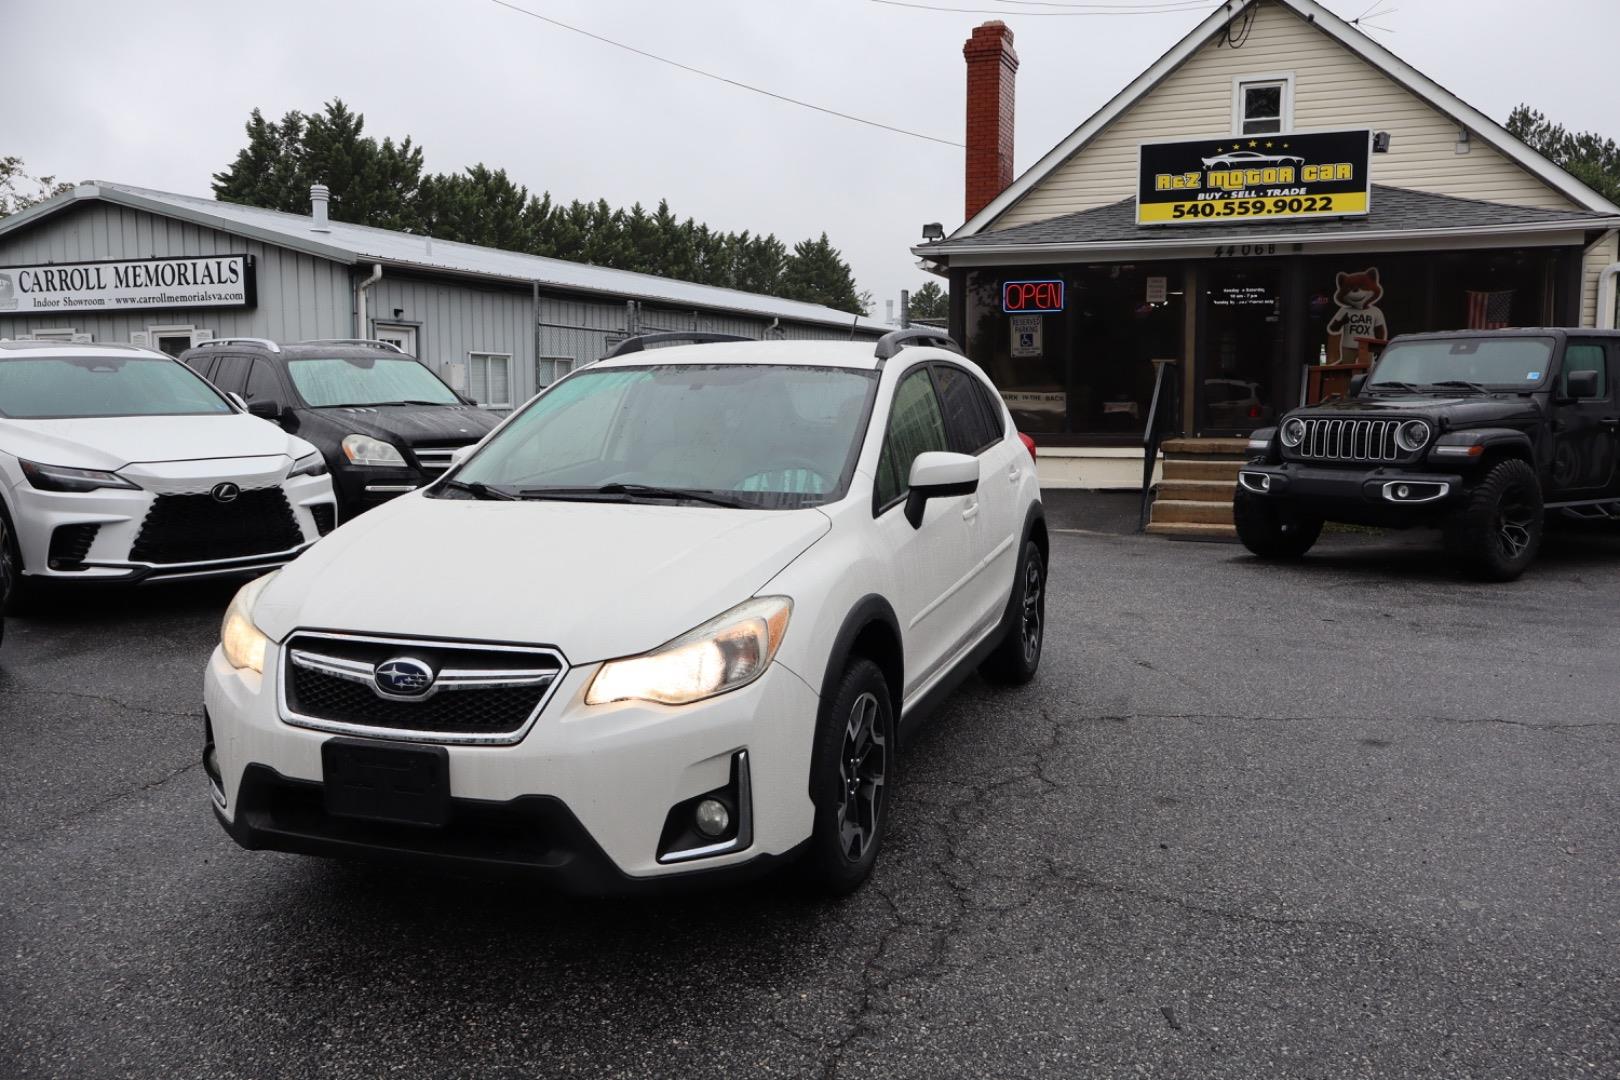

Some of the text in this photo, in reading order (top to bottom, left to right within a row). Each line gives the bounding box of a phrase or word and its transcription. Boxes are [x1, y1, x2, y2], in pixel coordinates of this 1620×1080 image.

[1197, 187, 1307, 200] BUY SELL TRADE
[1172, 196, 1333, 218] 540.559.9022
[19, 260, 240, 294] CARROLL MEMORIALS
[33, 292, 243, 307] Indoor Showroom www.carrollmemorialsva.com
[1006, 283, 1061, 309] OPEN
[1350, 314, 1372, 324] CAR
[1349, 324, 1371, 335] FOX
